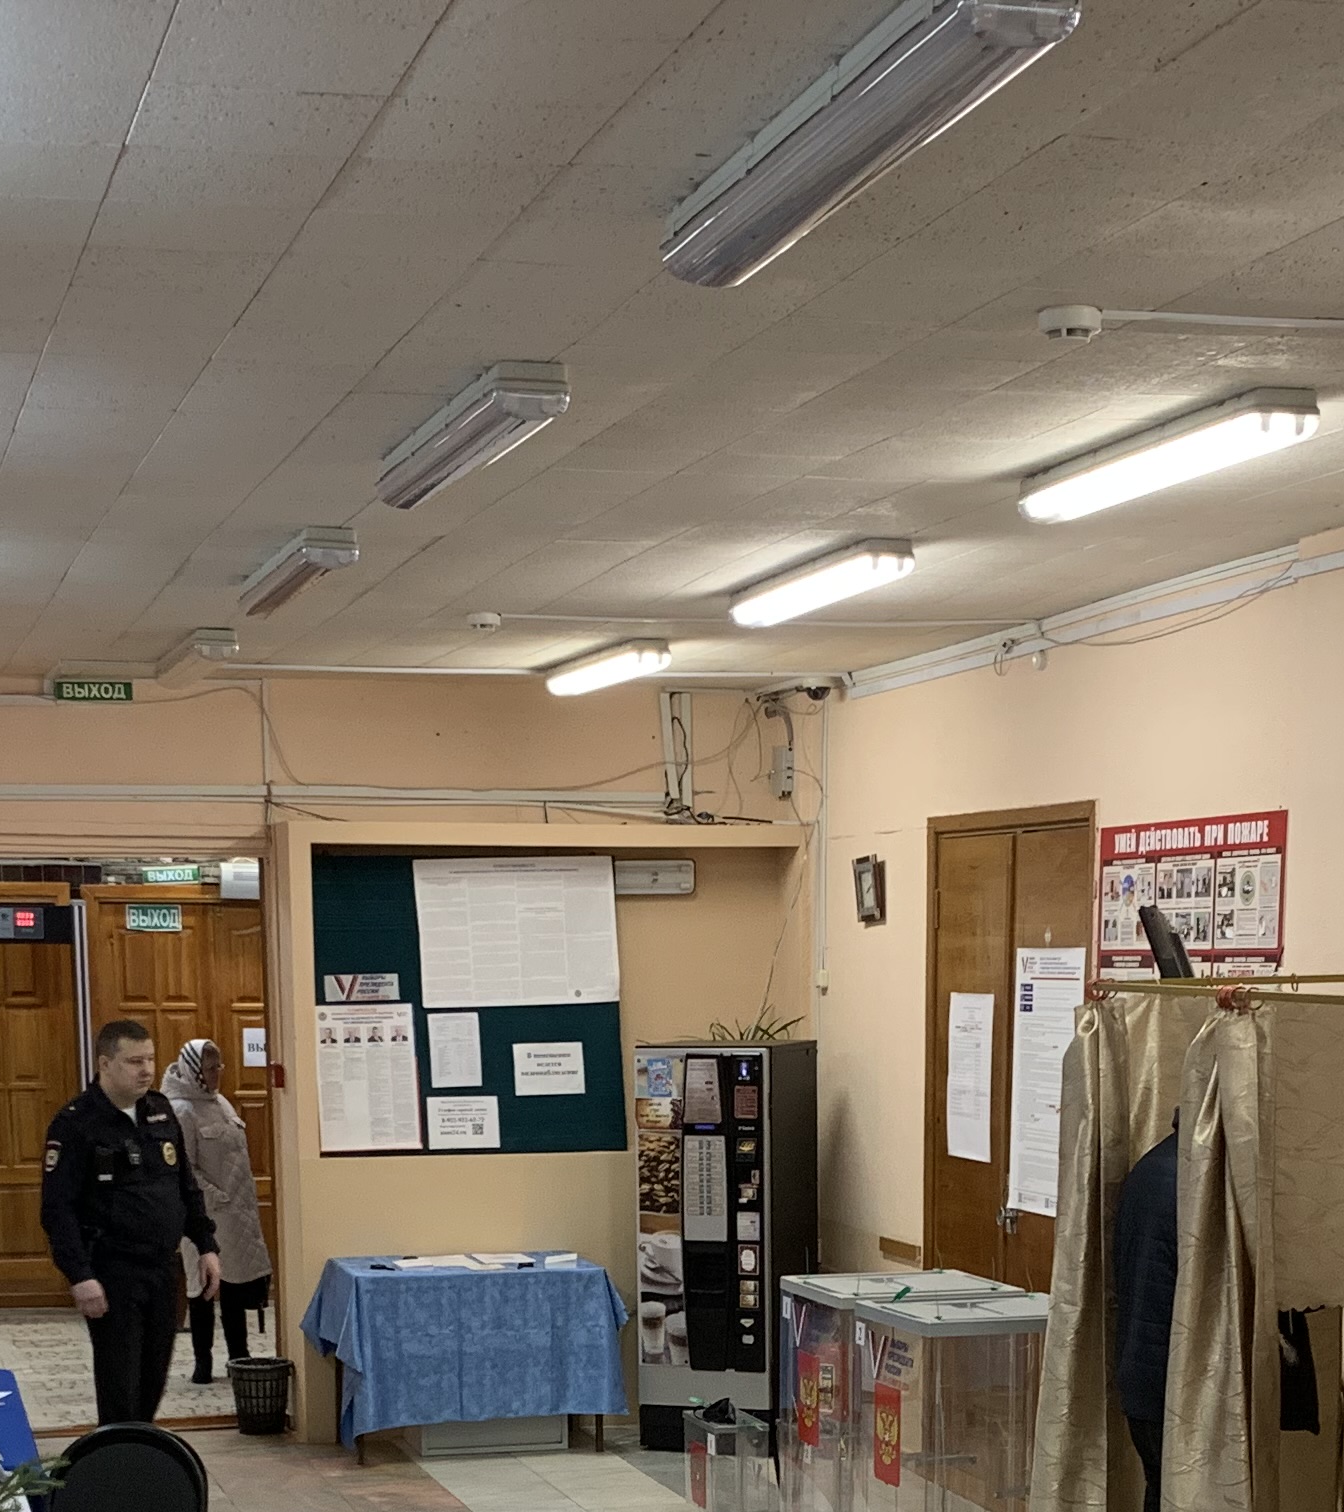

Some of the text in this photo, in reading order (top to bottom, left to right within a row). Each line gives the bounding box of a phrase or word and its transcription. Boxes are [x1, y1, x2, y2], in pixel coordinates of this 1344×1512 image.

[62, 684, 126, 699] ВЫХОД
[1114, 820, 1269, 854] УМЕЙ ДЕЙСТВОВАТЬ ПРИ ПОЖАРЕ
[148, 869, 194, 882] ВЫХОД
[130, 908, 180, 928] ВЫХОД
